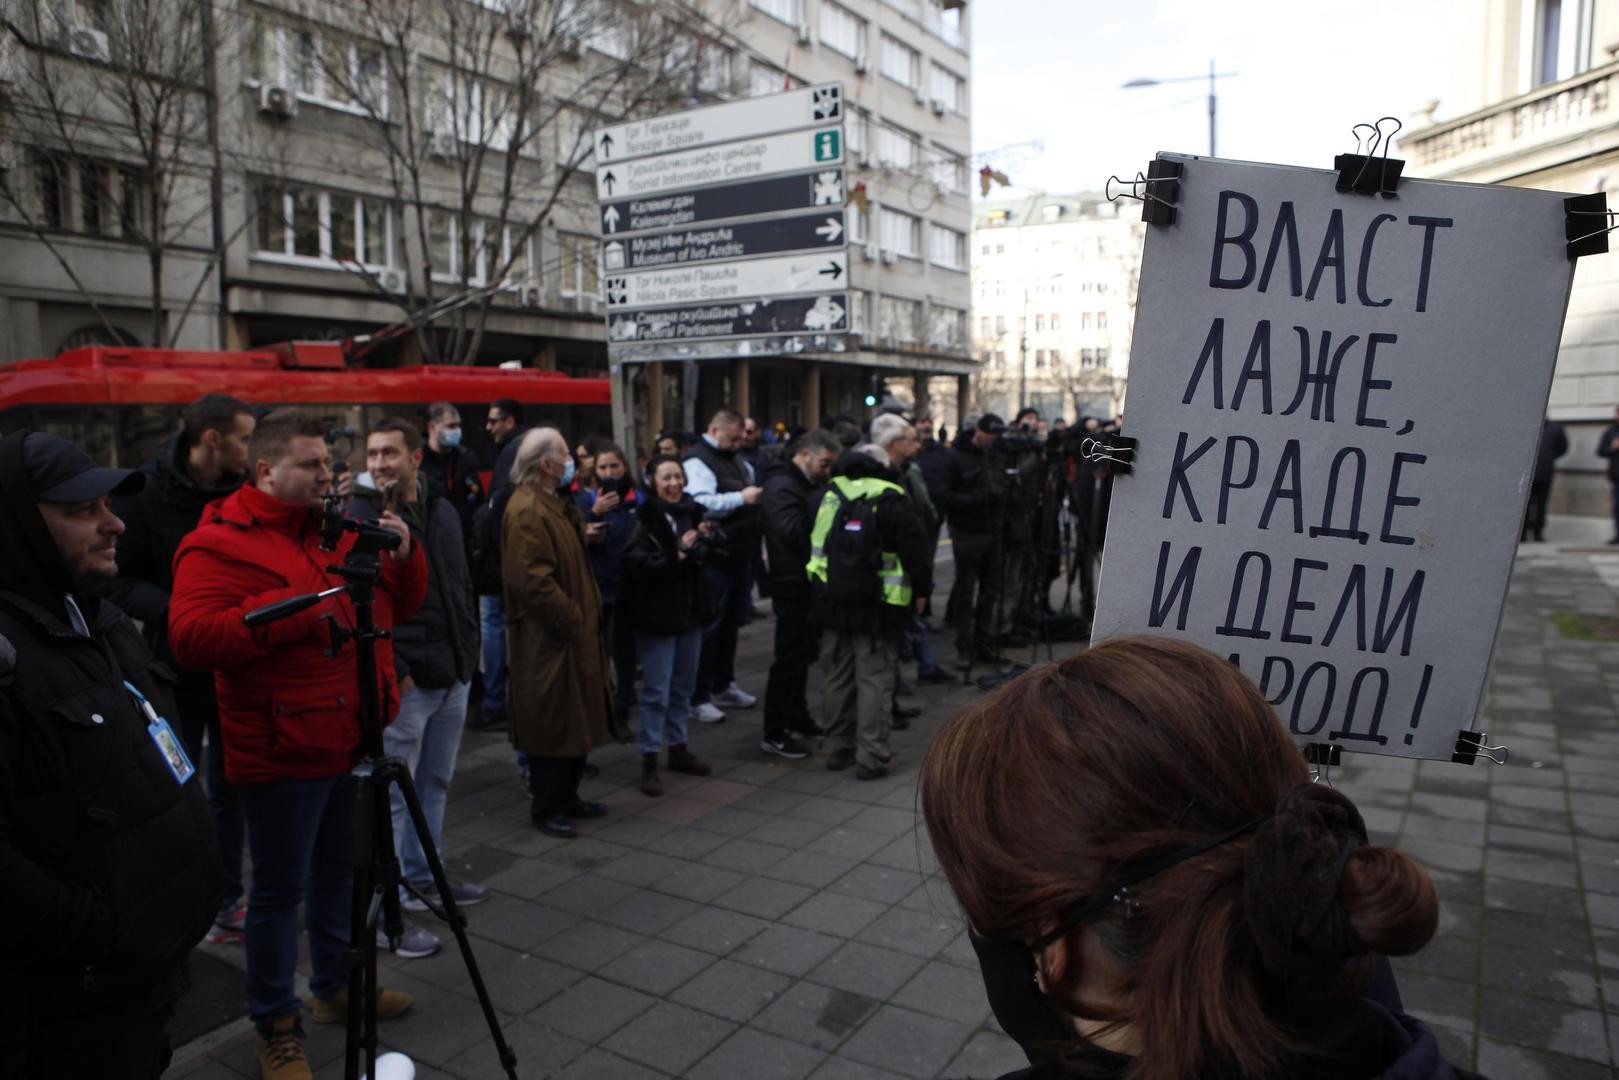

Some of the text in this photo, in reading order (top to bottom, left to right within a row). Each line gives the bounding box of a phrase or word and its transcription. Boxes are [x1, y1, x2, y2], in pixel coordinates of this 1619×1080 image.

[1209, 190, 1453, 312] ВЛАСТ
[1182, 318, 1415, 435] ЛАЖЕ,
[1162, 432, 1427, 546] КРАДЕ
[1148, 542, 1426, 657] И ДЕЛИ
[1228, 653, 1434, 746] РОД!
